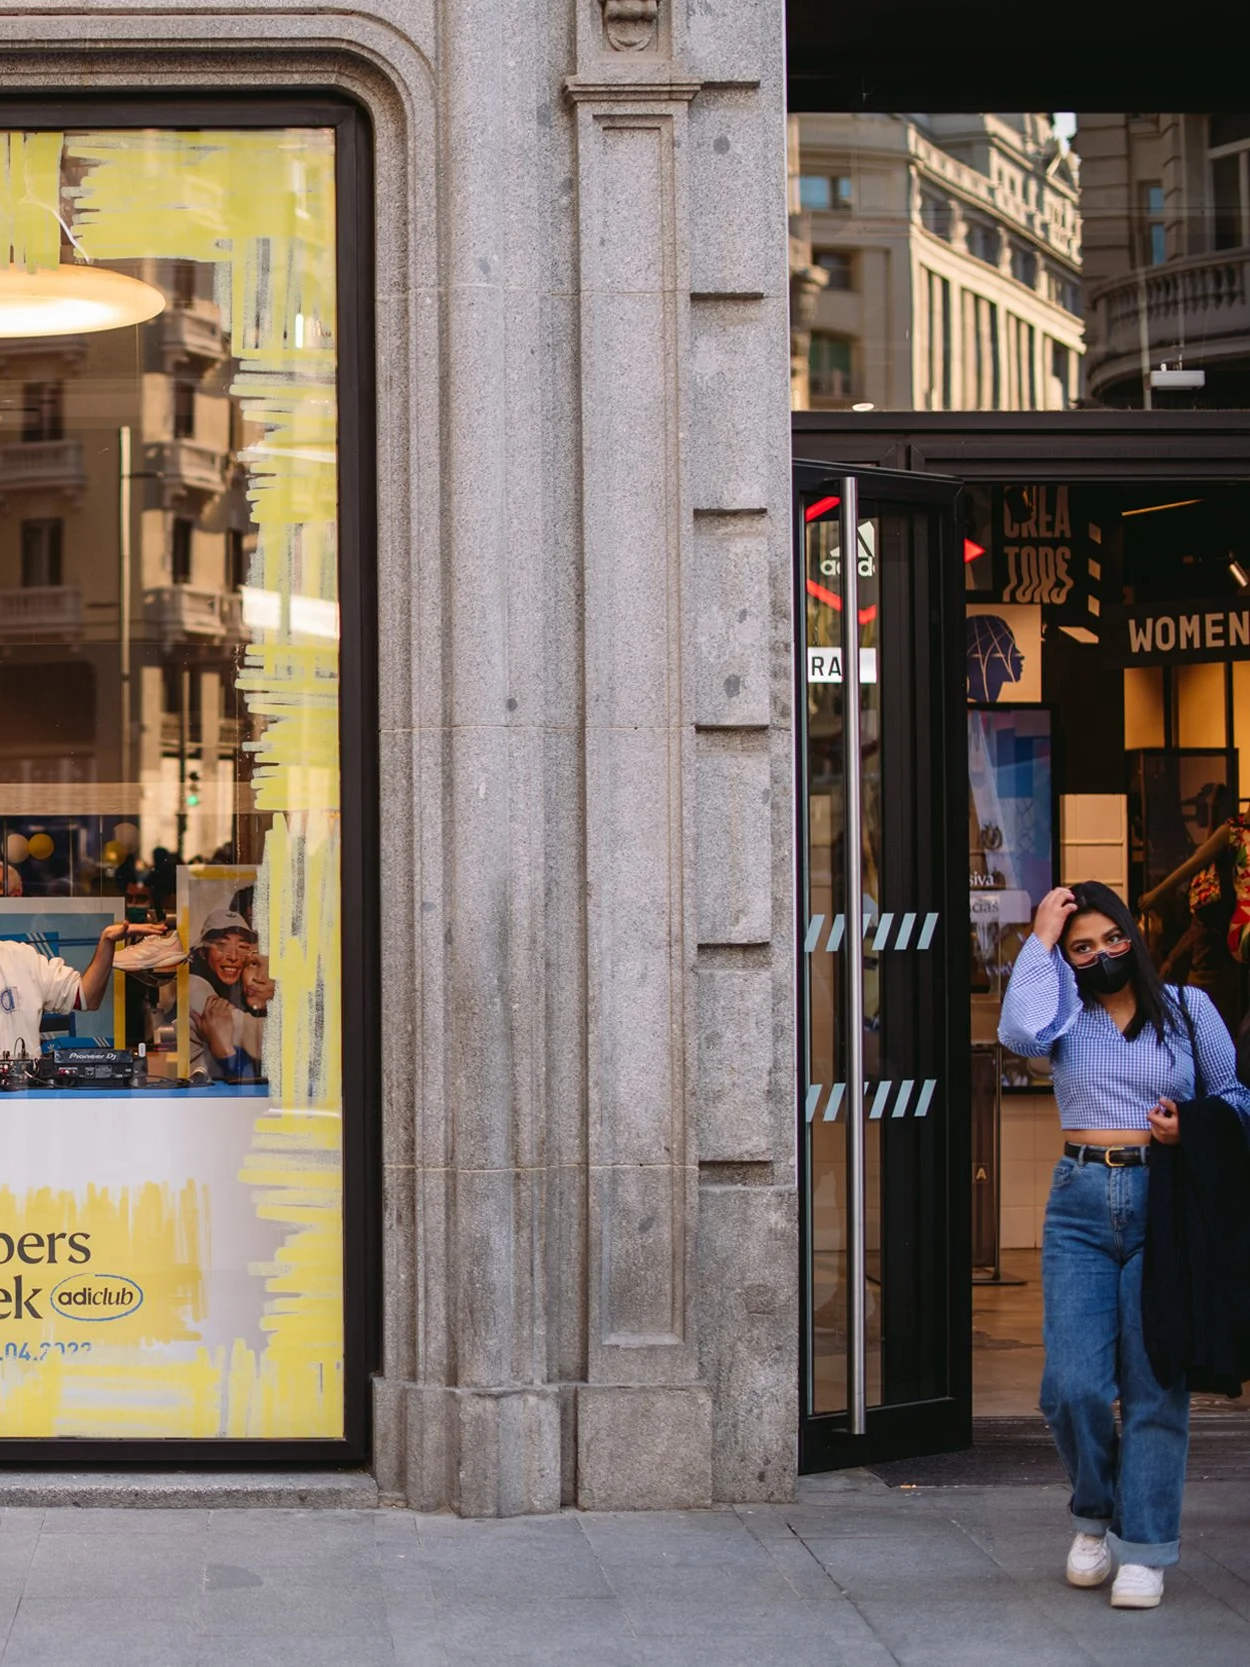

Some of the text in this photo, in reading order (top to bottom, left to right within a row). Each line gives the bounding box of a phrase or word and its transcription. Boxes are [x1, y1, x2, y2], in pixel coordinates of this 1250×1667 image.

[1001, 545, 1075, 605] TORS
[1128, 611, 1250, 653] WOMEN
[69, 1052, 104, 1060] Pioneer
[57, 1287, 134, 1306] adiclub
